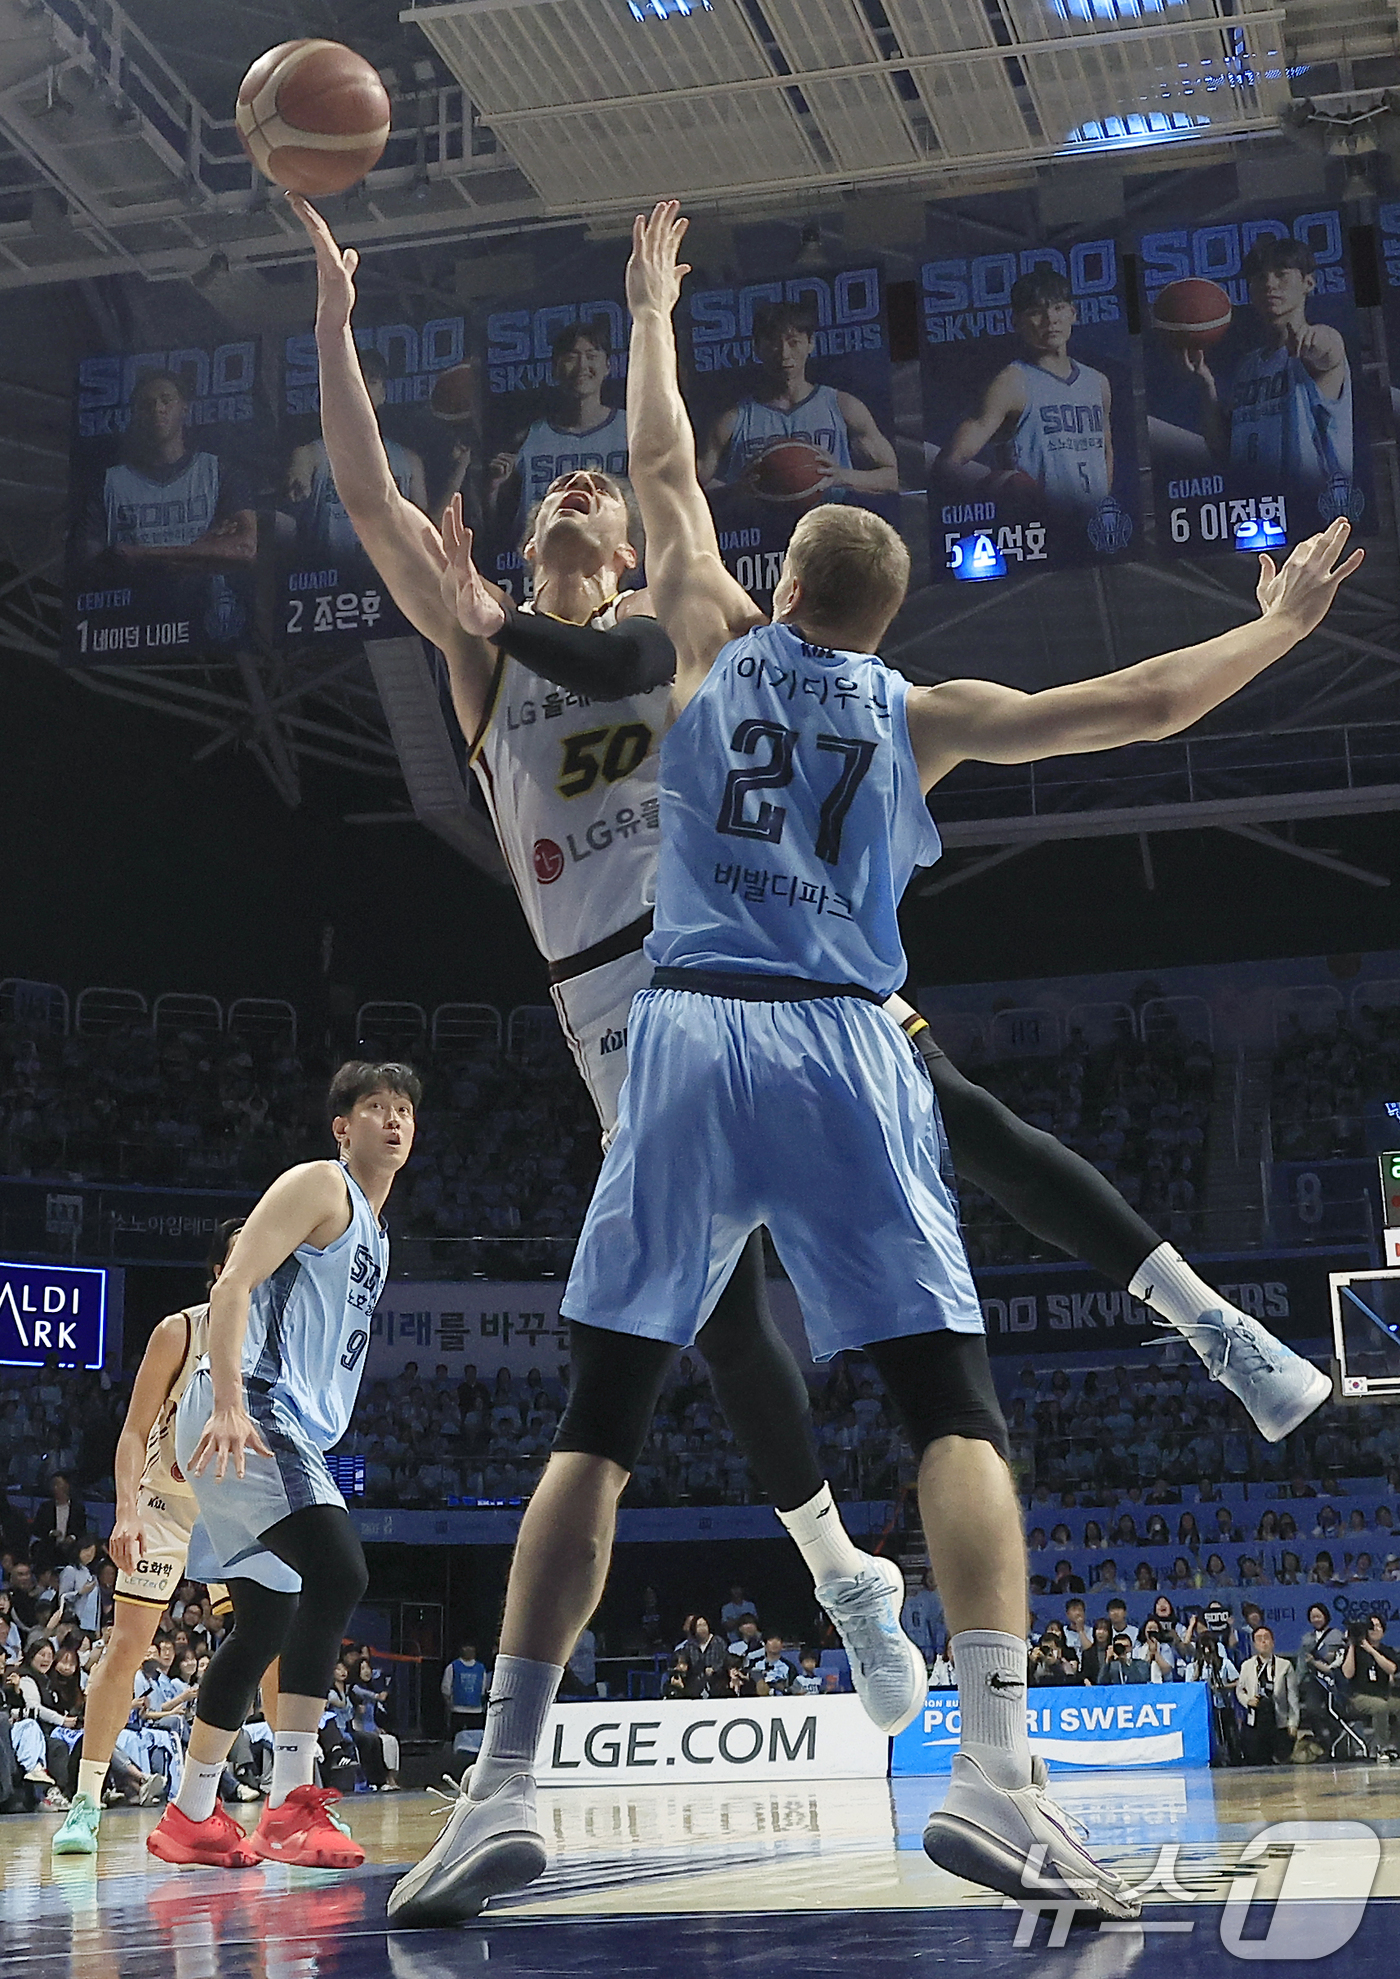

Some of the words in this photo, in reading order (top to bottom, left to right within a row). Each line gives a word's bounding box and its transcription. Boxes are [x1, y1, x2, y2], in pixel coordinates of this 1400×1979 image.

[1168, 474, 1224, 499] GUARD
[942, 501, 996, 524] GUARD
[1170, 507, 1191, 543] 6
[1200, 495, 1288, 540] 이정현
[945, 532, 964, 569] 5
[289, 569, 338, 591] GUARD
[77, 588, 132, 612] CENTER
[286, 600, 303, 633] 2
[313, 590, 381, 632] 조은후
[77, 619, 89, 653] 1
[146, 621, 189, 647] 나이트
[507, 700, 537, 731] LG
[555, 721, 655, 801] 50
[716, 718, 878, 866] 27
[714, 861, 855, 922] 비발디파크
[340, 1329, 368, 1371] 9
[1060, 1703, 1177, 1732] SWEAT
[551, 1715, 818, 1769] LGE.COM
